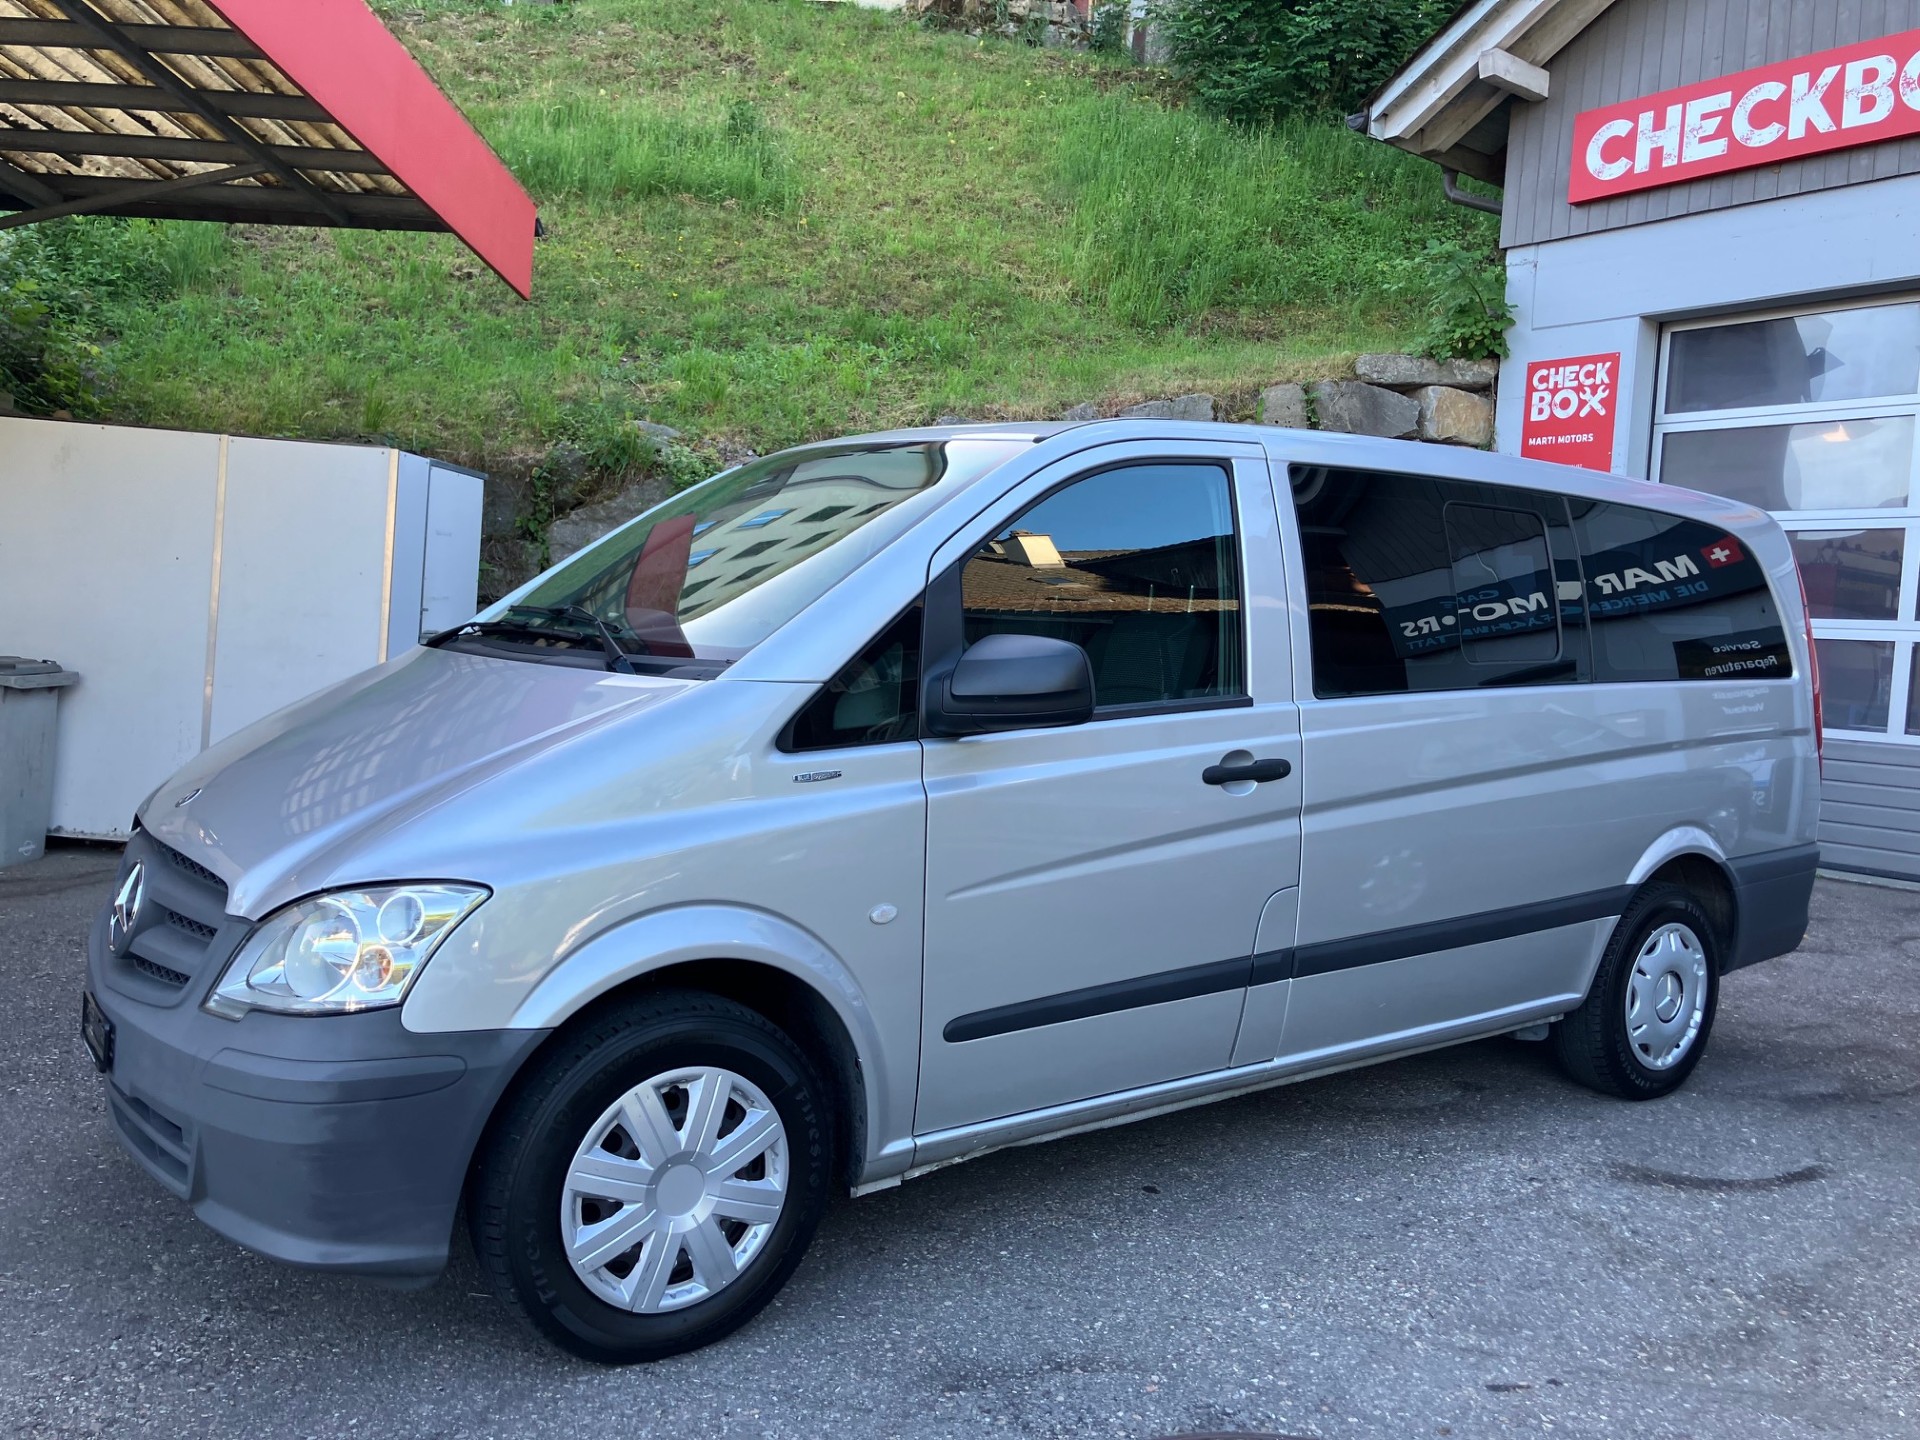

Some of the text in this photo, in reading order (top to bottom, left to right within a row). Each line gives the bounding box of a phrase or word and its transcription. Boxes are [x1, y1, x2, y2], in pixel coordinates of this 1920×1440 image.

[1531, 361, 1612, 391] CHECK
[1530, 384, 1610, 422] BOX
[1528, 432, 1594, 446] MARTI MOTORS
